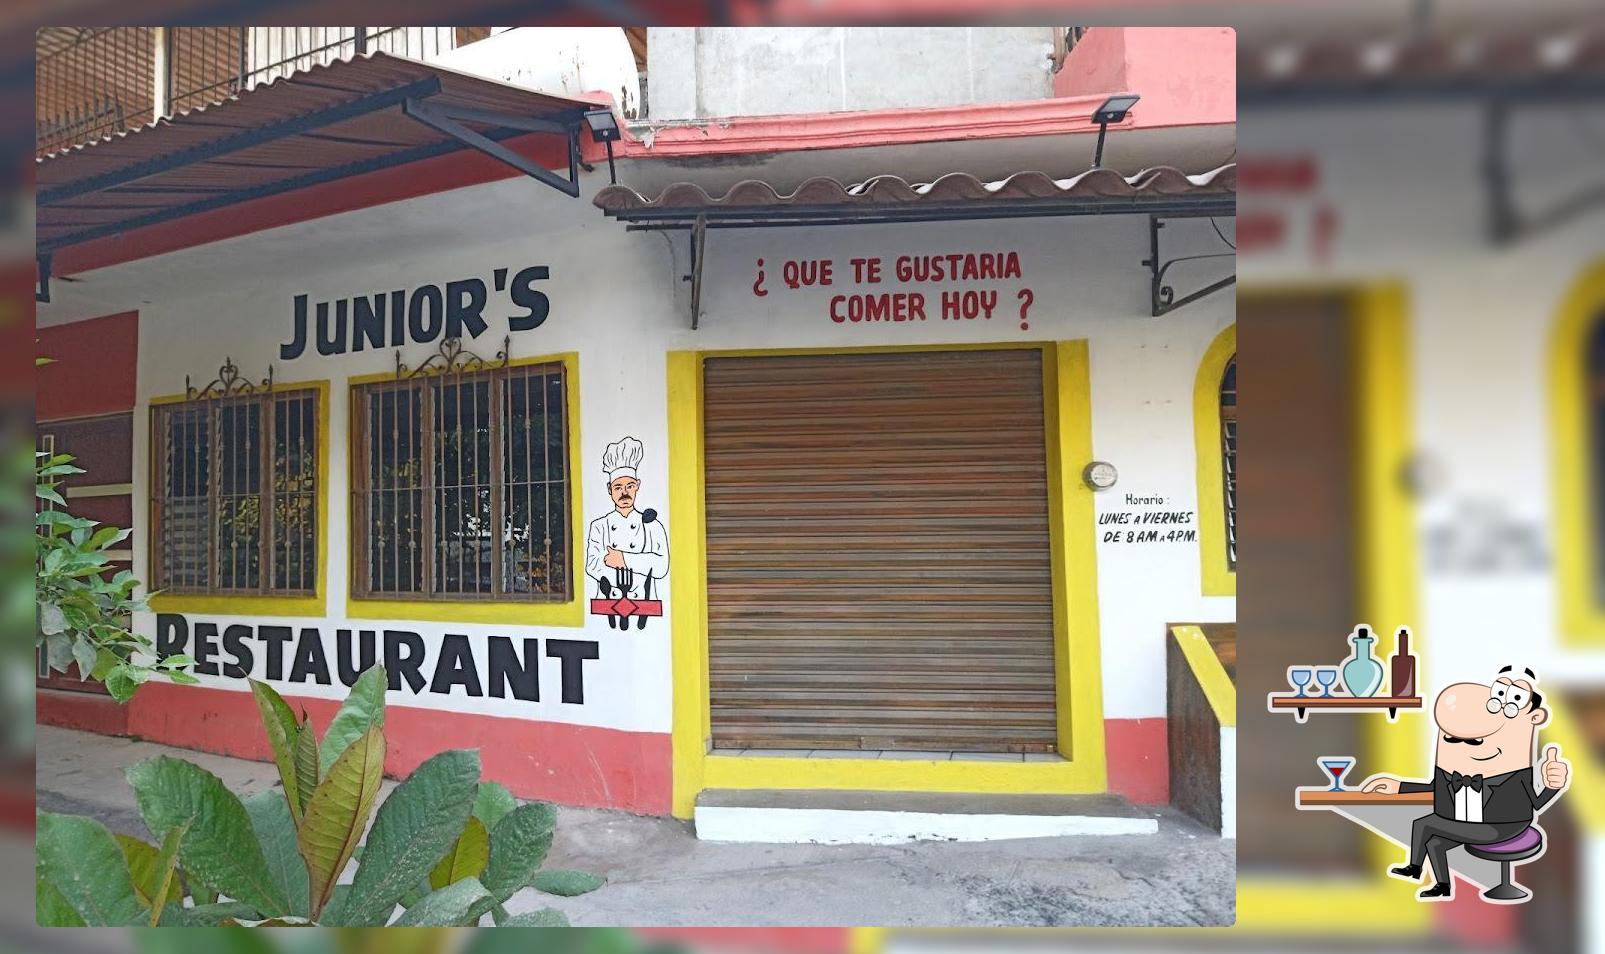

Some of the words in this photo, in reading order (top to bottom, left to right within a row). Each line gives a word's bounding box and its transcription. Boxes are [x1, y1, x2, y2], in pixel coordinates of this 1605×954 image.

[783, 259, 833, 289] QUE
[850, 257, 881, 284] TE
[896, 251, 1022, 283] GUSTARIA
[280, 265, 550, 361] JUNIOR'S
[829, 292, 926, 323] COMER
[941, 289, 997, 321] HOY
[1125, 493, 1164, 505] Horario
[1098, 512, 1133, 525] LUNES
[1142, 511, 1194, 525] VIERNES
[1103, 530, 1122, 543] DE
[156, 612, 600, 706] RESTAURANT
